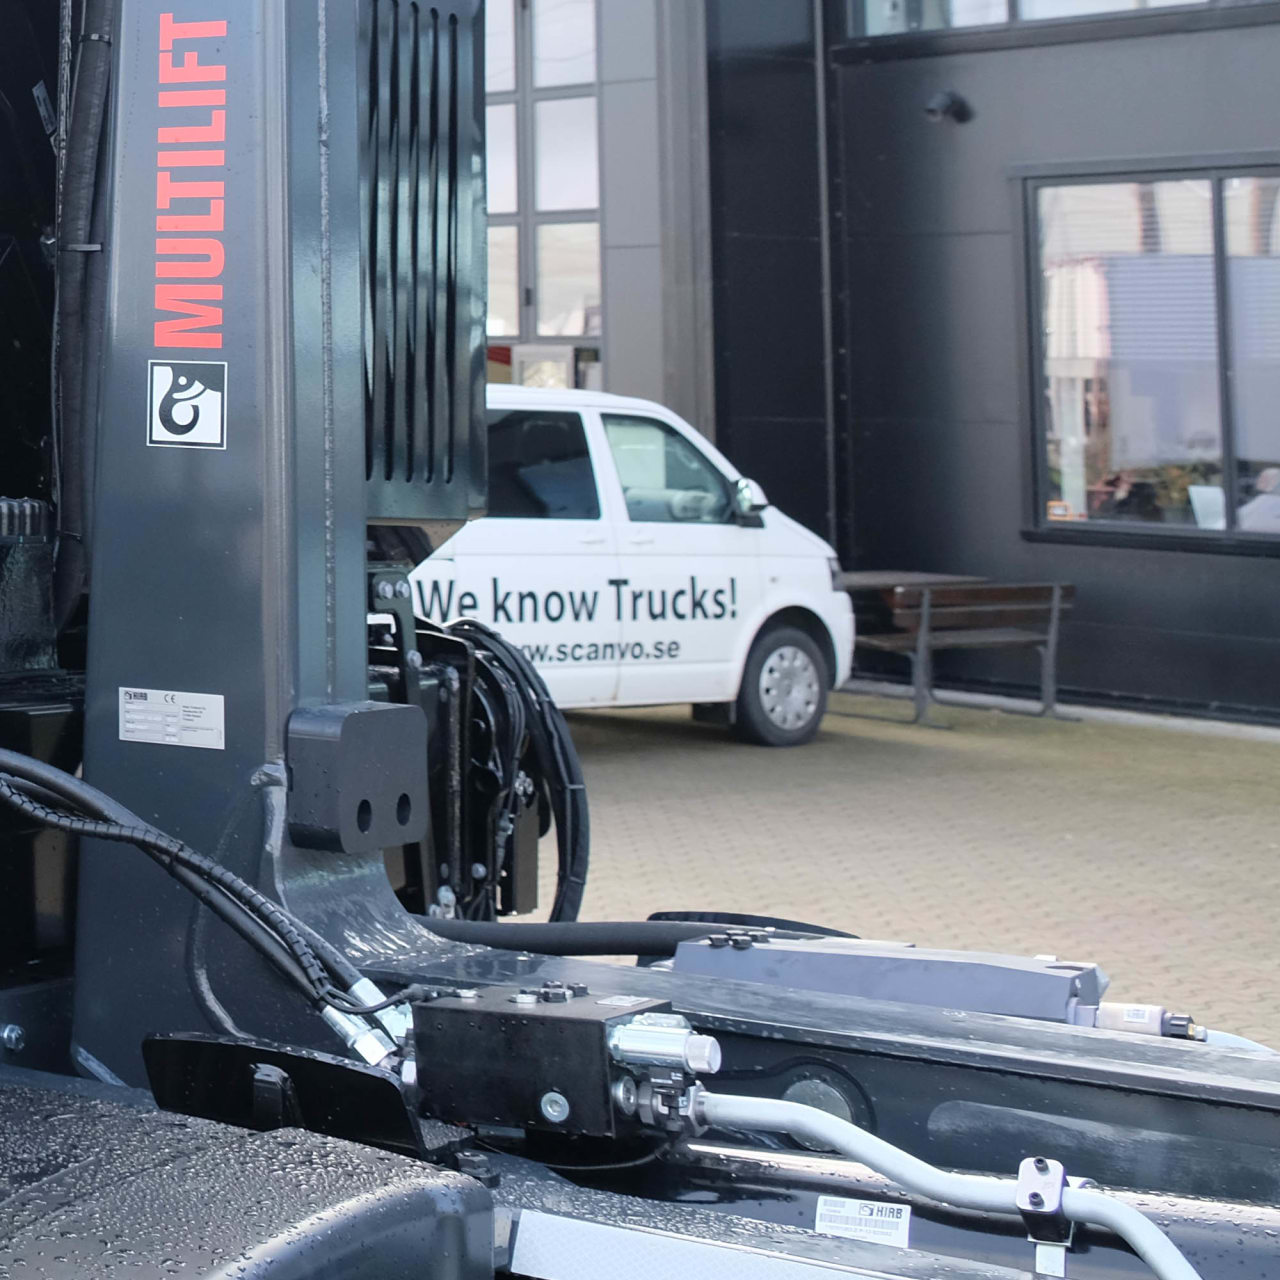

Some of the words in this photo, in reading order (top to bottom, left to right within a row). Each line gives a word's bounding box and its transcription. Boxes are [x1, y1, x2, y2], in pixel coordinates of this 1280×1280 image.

[154, 13, 227, 348] MULTILIFT
[416, 578, 479, 620] We
[492, 577, 599, 623] know
[607, 575, 738, 621] Trucks!
[876, 1205, 903, 1219] HIAB
